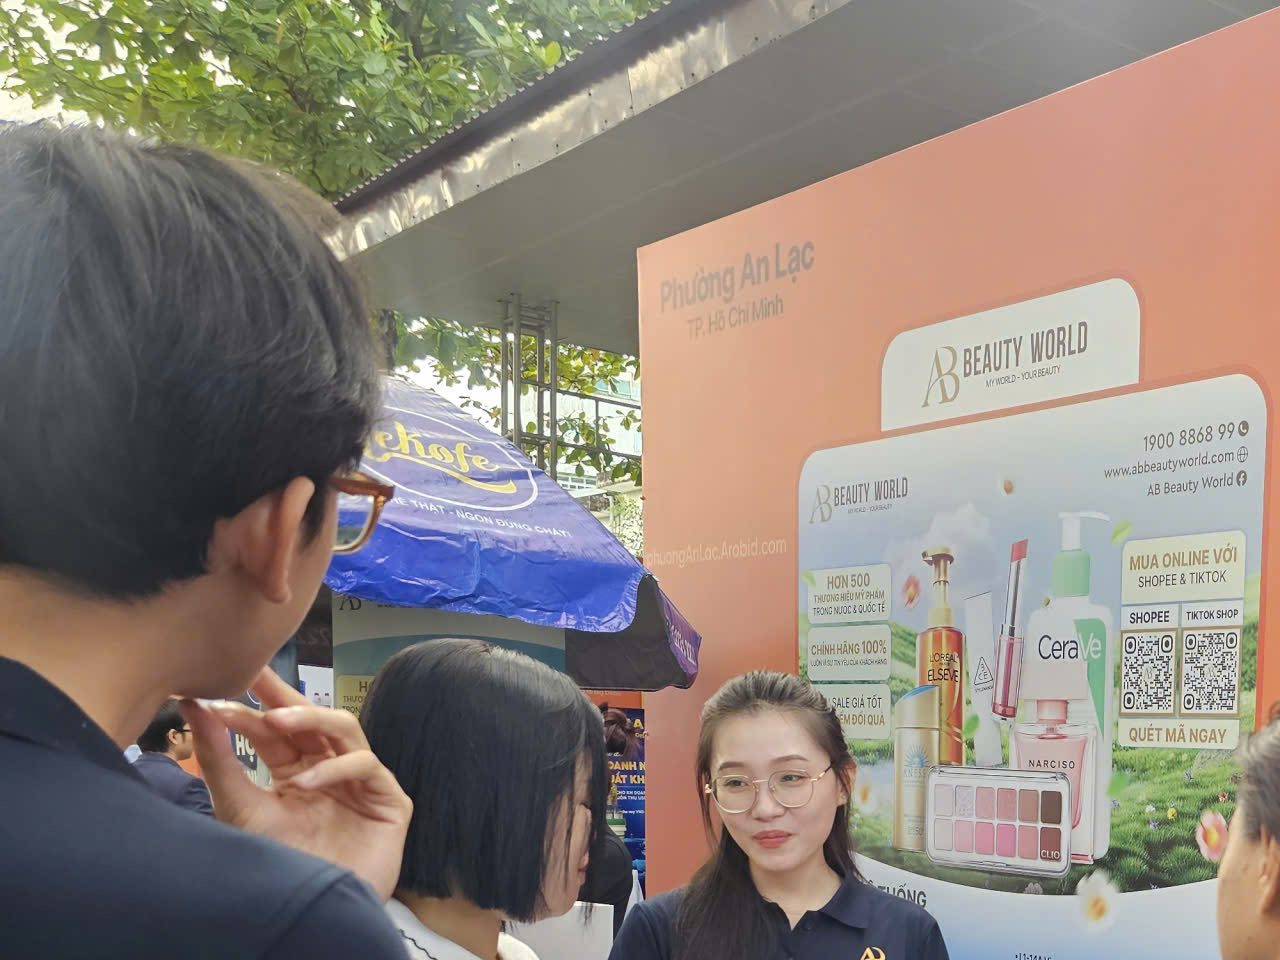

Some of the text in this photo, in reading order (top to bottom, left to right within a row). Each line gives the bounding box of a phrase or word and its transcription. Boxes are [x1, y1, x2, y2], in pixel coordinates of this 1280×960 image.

[741, 252, 770, 289] An
[775, 240, 817, 284] Lạc
[753, 293, 785, 321] Minh
[963, 335, 1023, 378] BEAUTY
[1030, 320, 1089, 364] WORLD
[985, 365, 1061, 388] MY WORLD YOUR BEAUTY
[1143, 422, 1235, 452] 1900 8868 99
[1104, 451, 1234, 479] www.abbeautyworld.com
[834, 477, 908, 507] BEAUTY WORLD
[1147, 473, 1233, 497] AB Beauty World
[1129, 543, 1238, 572] MUA ONLINE VỚI
[851, 572, 871, 588] 500
[1137, 570, 1227, 589] SHOPEE & TIKTOK
[1129, 610, 1170, 625] SHOPEE
[1185, 608, 1239, 622] TIKTOK SHOP
[862, 639, 887, 654] 100%
[1038, 632, 1102, 661] CeraVe
[927, 668, 959, 683] ELSEVE
[832, 697, 850, 709] SALE
[1128, 723, 1227, 745] QUÉT MÃ NGAY
[1028, 759, 1075, 769] NARCISO
[1040, 849, 1060, 860] CLIO
